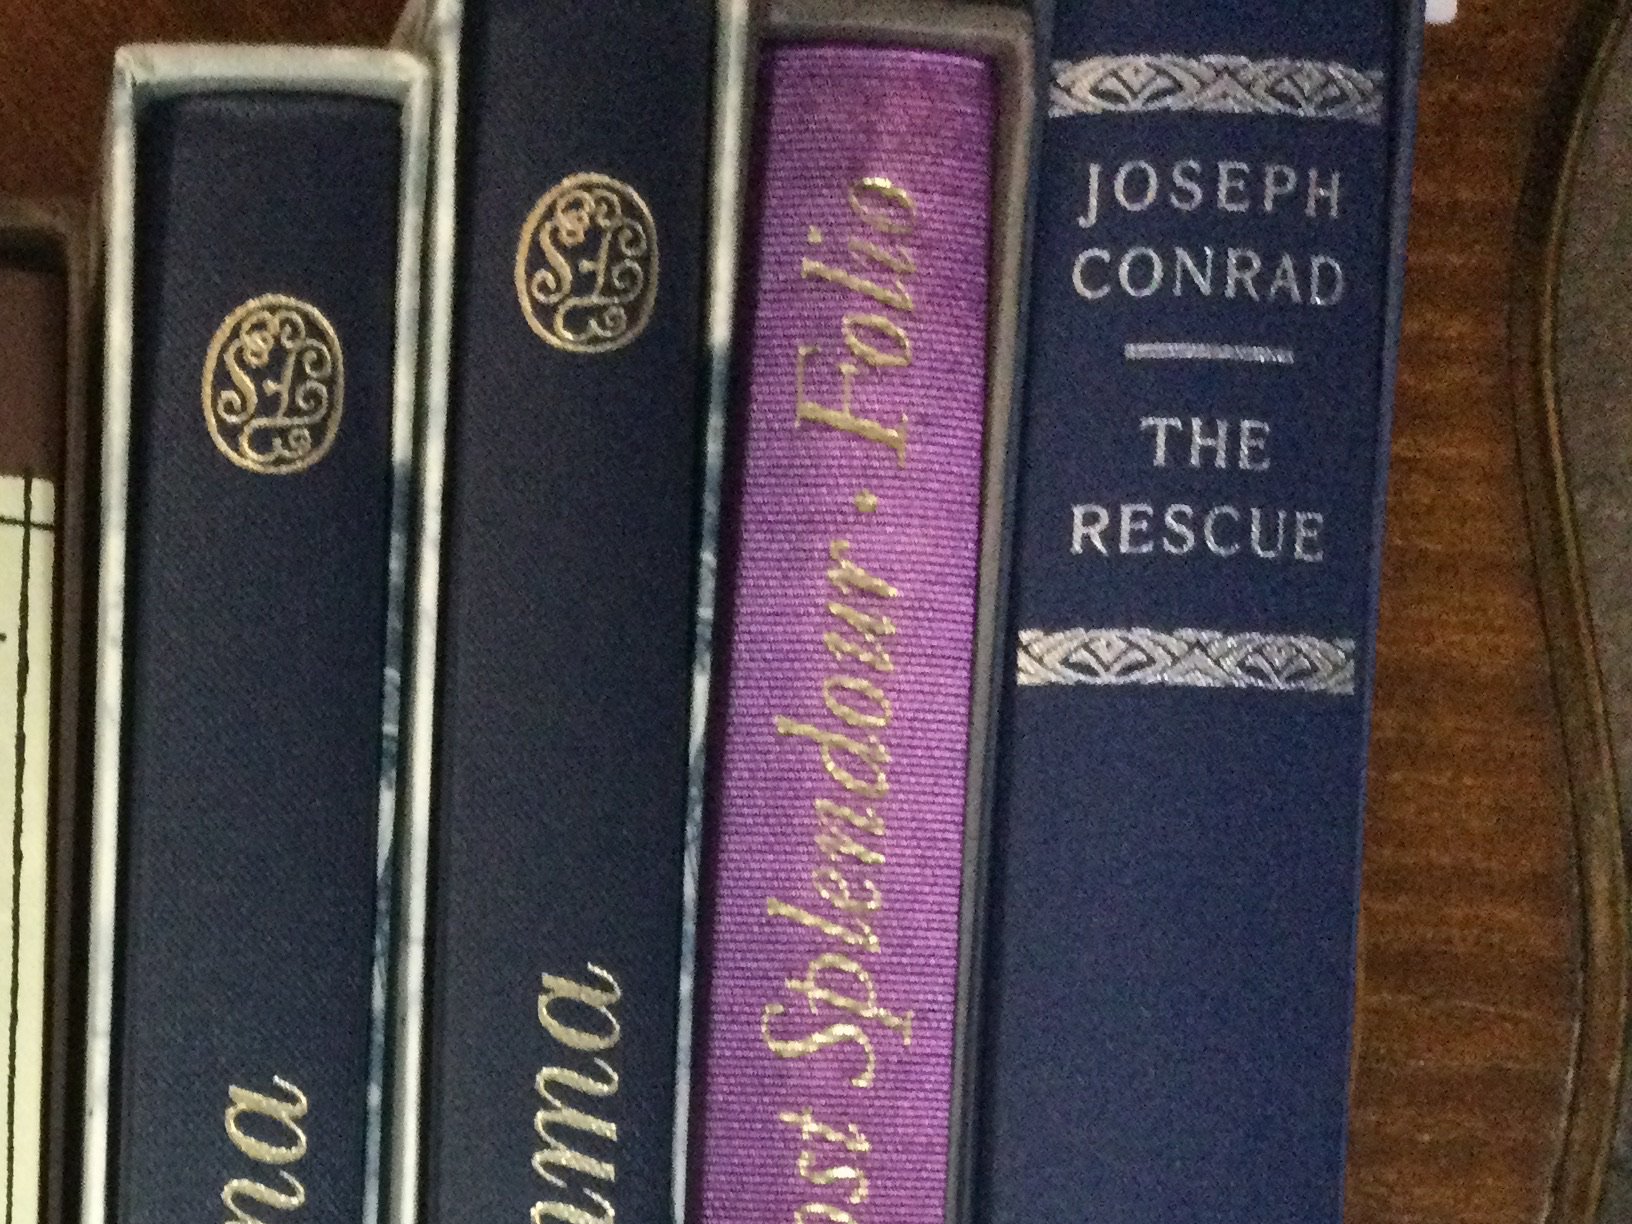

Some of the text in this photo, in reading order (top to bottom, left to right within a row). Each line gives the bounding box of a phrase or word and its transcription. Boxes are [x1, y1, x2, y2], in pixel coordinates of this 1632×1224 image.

[1078, 159, 1342, 229] JOSEPH
[1072, 246, 1345, 306] CONRAD
[795, 176, 917, 470] Folio
[1140, 416, 1272, 472] THE
[1069, 502, 1325, 563] RESCUE
[761, 540, 913, 1088] Splendour
